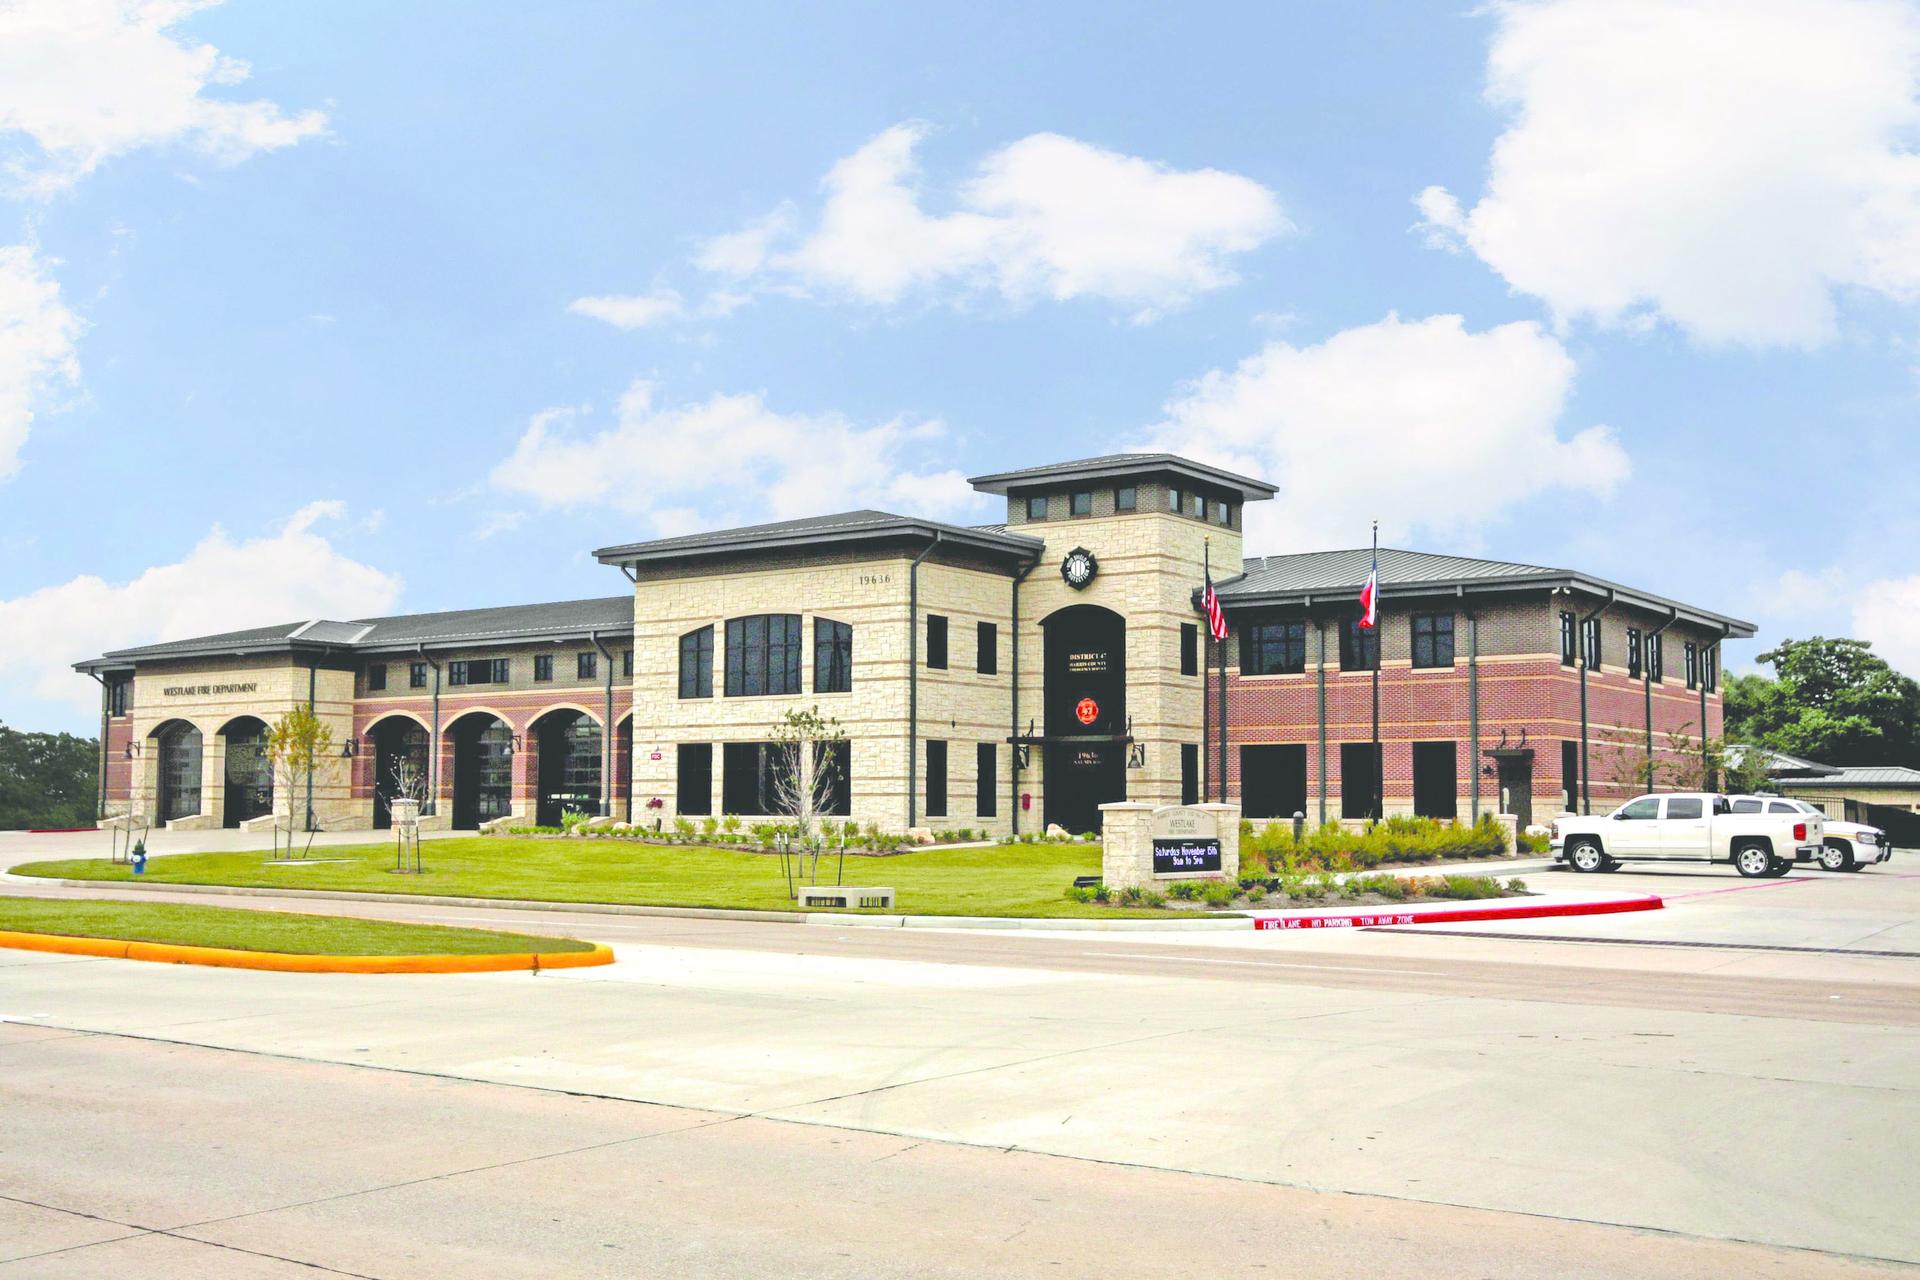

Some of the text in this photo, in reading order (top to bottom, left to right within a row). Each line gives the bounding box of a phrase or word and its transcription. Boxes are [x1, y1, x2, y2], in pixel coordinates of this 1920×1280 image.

[859, 574, 890, 585] 19636
[163, 682, 257, 696] WESTLAKE FIRE DEPARTMENT
[1082, 707, 1092, 715] 47
[1170, 819, 1196, 829] WESTLAKE
[1155, 846, 1180, 857] Saturday
[1181, 845, 1206, 856] November
[1185, 855, 1192, 865] to
[1263, 915, 1414, 930] FIRE LANE NO PARKING TOW AWAY ZONE
